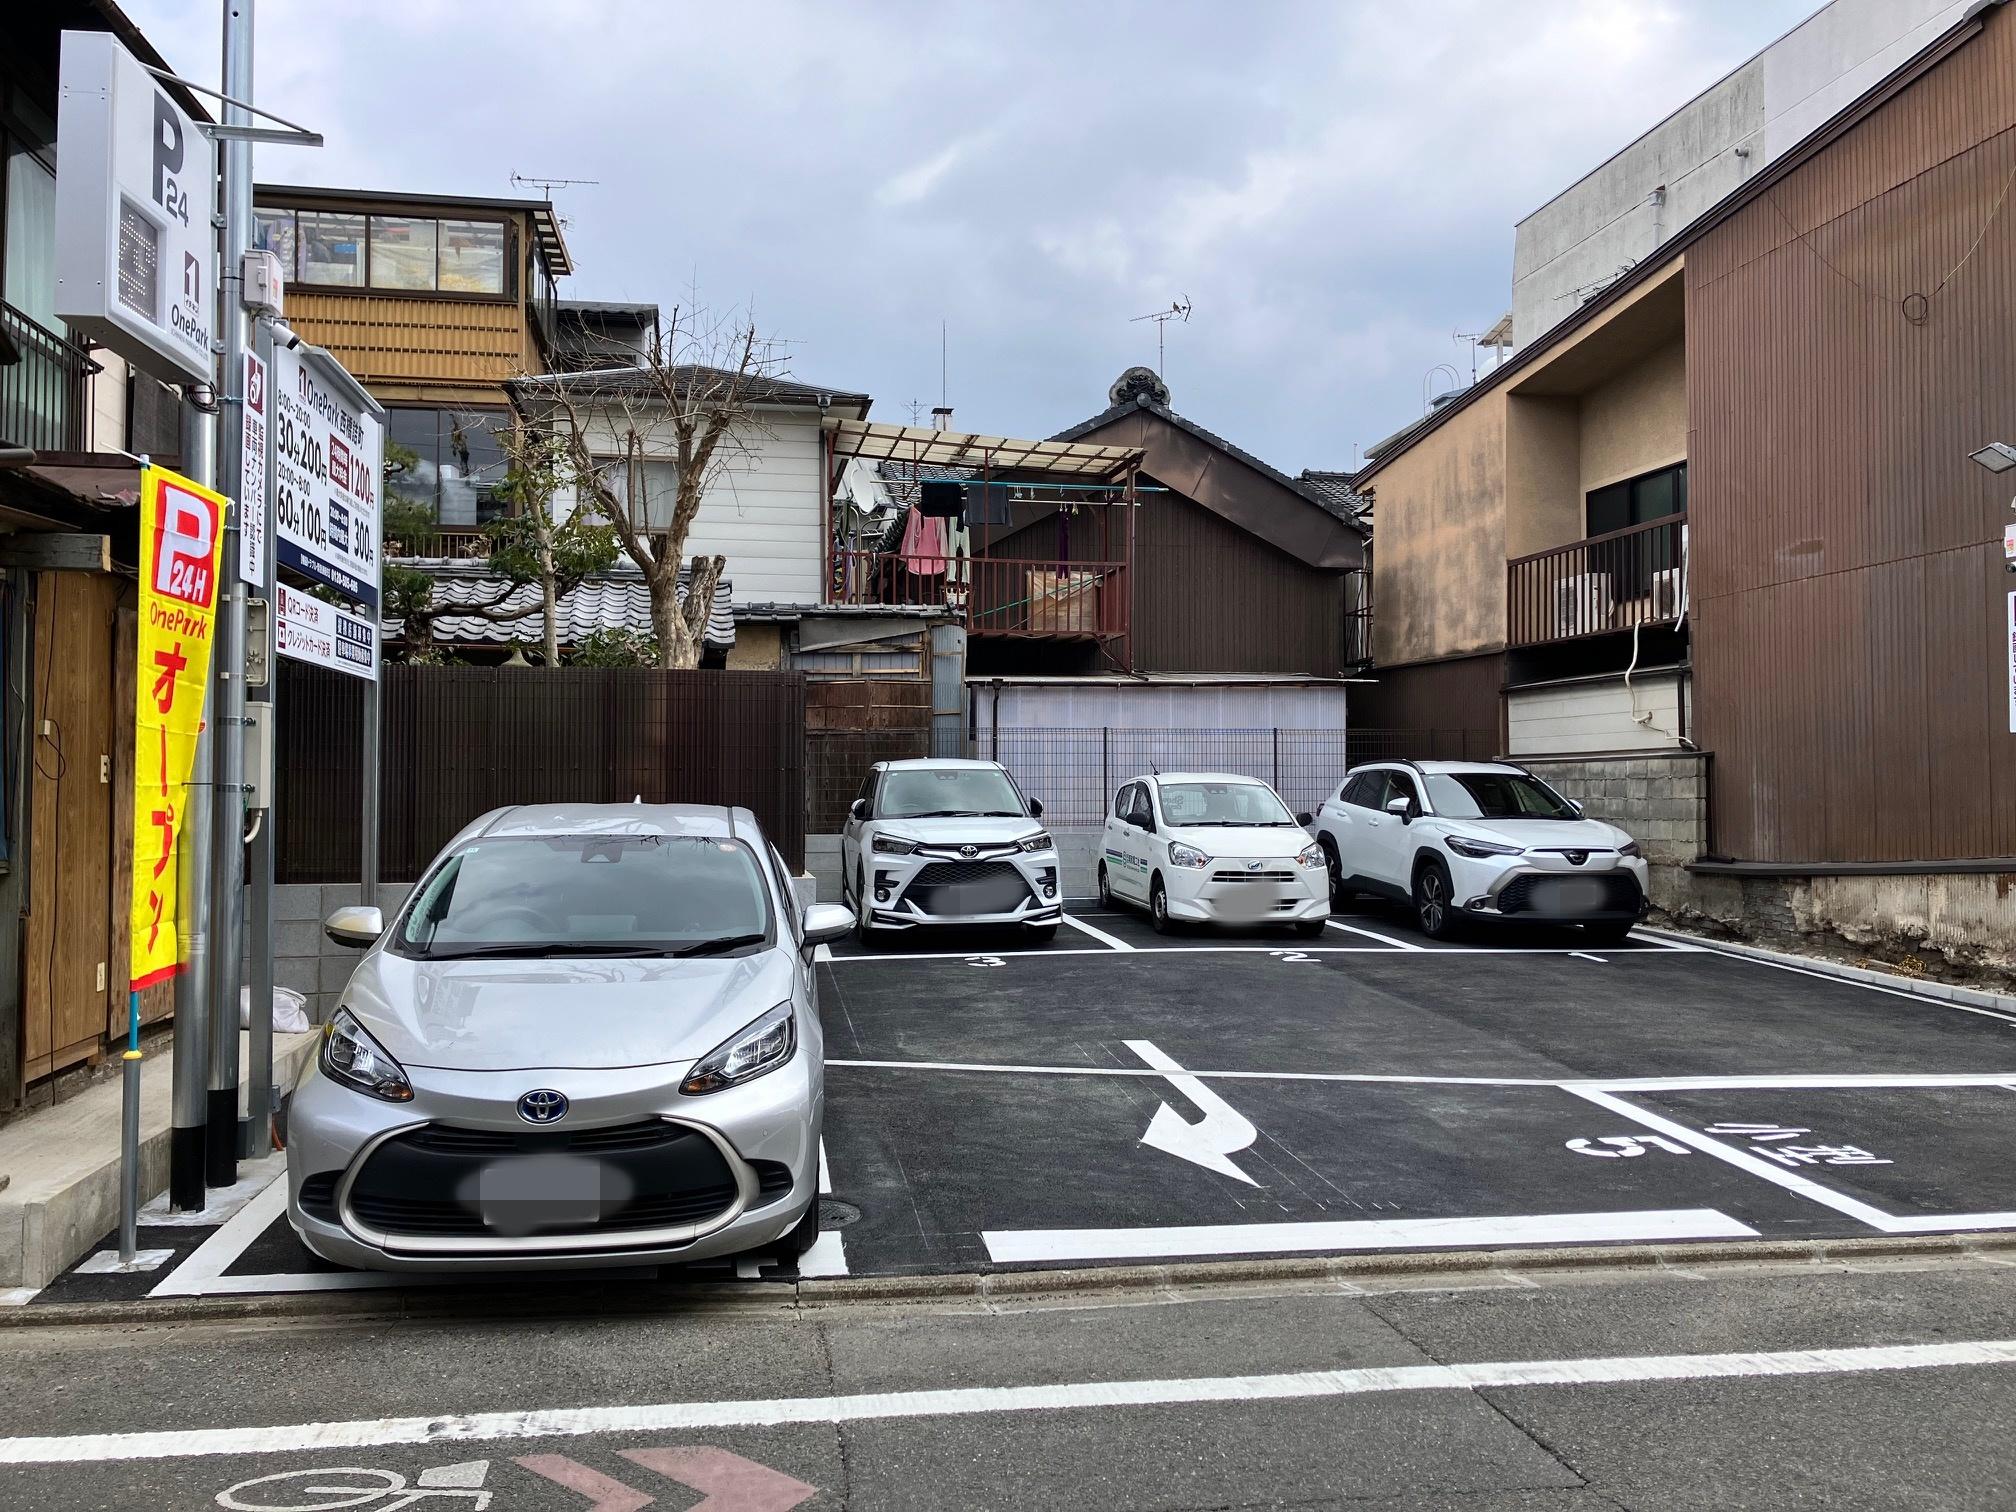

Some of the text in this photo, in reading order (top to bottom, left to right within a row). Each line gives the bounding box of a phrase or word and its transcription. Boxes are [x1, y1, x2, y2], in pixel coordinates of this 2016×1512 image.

[153, 88, 190, 228] P 24
[171, 304, 208, 350] OnePark
[307, 379, 339, 428] OnePark
[350, 454, 374, 509] 1200円
[157, 485, 211, 603] P 24H
[354, 518, 374, 567] 300円
[150, 602, 208, 640] OnePark
[288, 596, 319, 624] QRコード決済
[288, 630, 331, 659] クレジットカード決済
[148, 642, 187, 954] オープン
[964, 956, 1006, 968] 3
[1270, 952, 1322, 963] 2
[1566, 1135, 1692, 1158] 5
[1705, 1122, 1894, 1167] 小型
